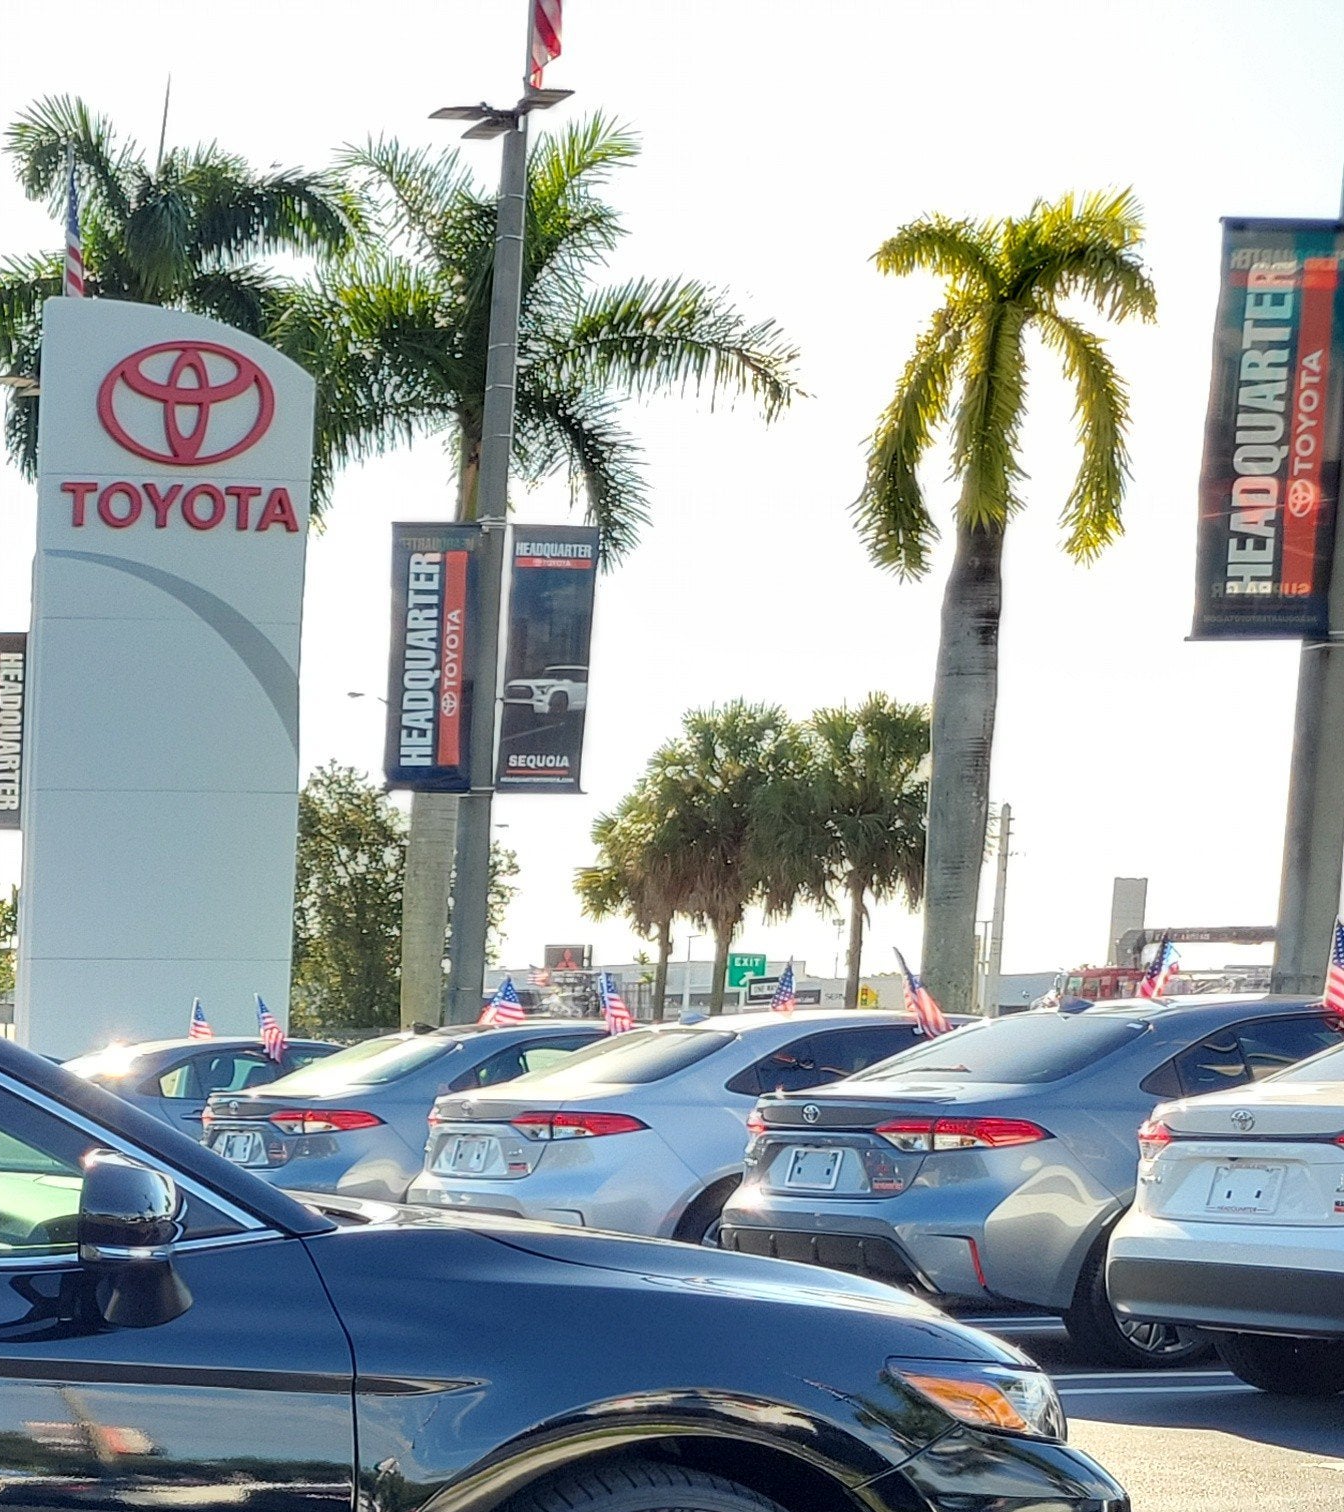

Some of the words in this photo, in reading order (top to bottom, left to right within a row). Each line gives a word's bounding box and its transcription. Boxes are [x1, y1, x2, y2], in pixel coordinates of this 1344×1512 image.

[1226, 261, 1298, 595] HEADQUARTER
[1293, 350, 1324, 476] TOYOTA
[61, 481, 300, 533] TOYOTA
[515, 542, 592, 559] HEADQUARTER
[399, 552, 442, 767] HEADQUARTER
[444, 609, 462, 689] TOYOTA
[508, 754, 570, 769] SEQUOIA
[734, 957, 761, 967] EXIT
